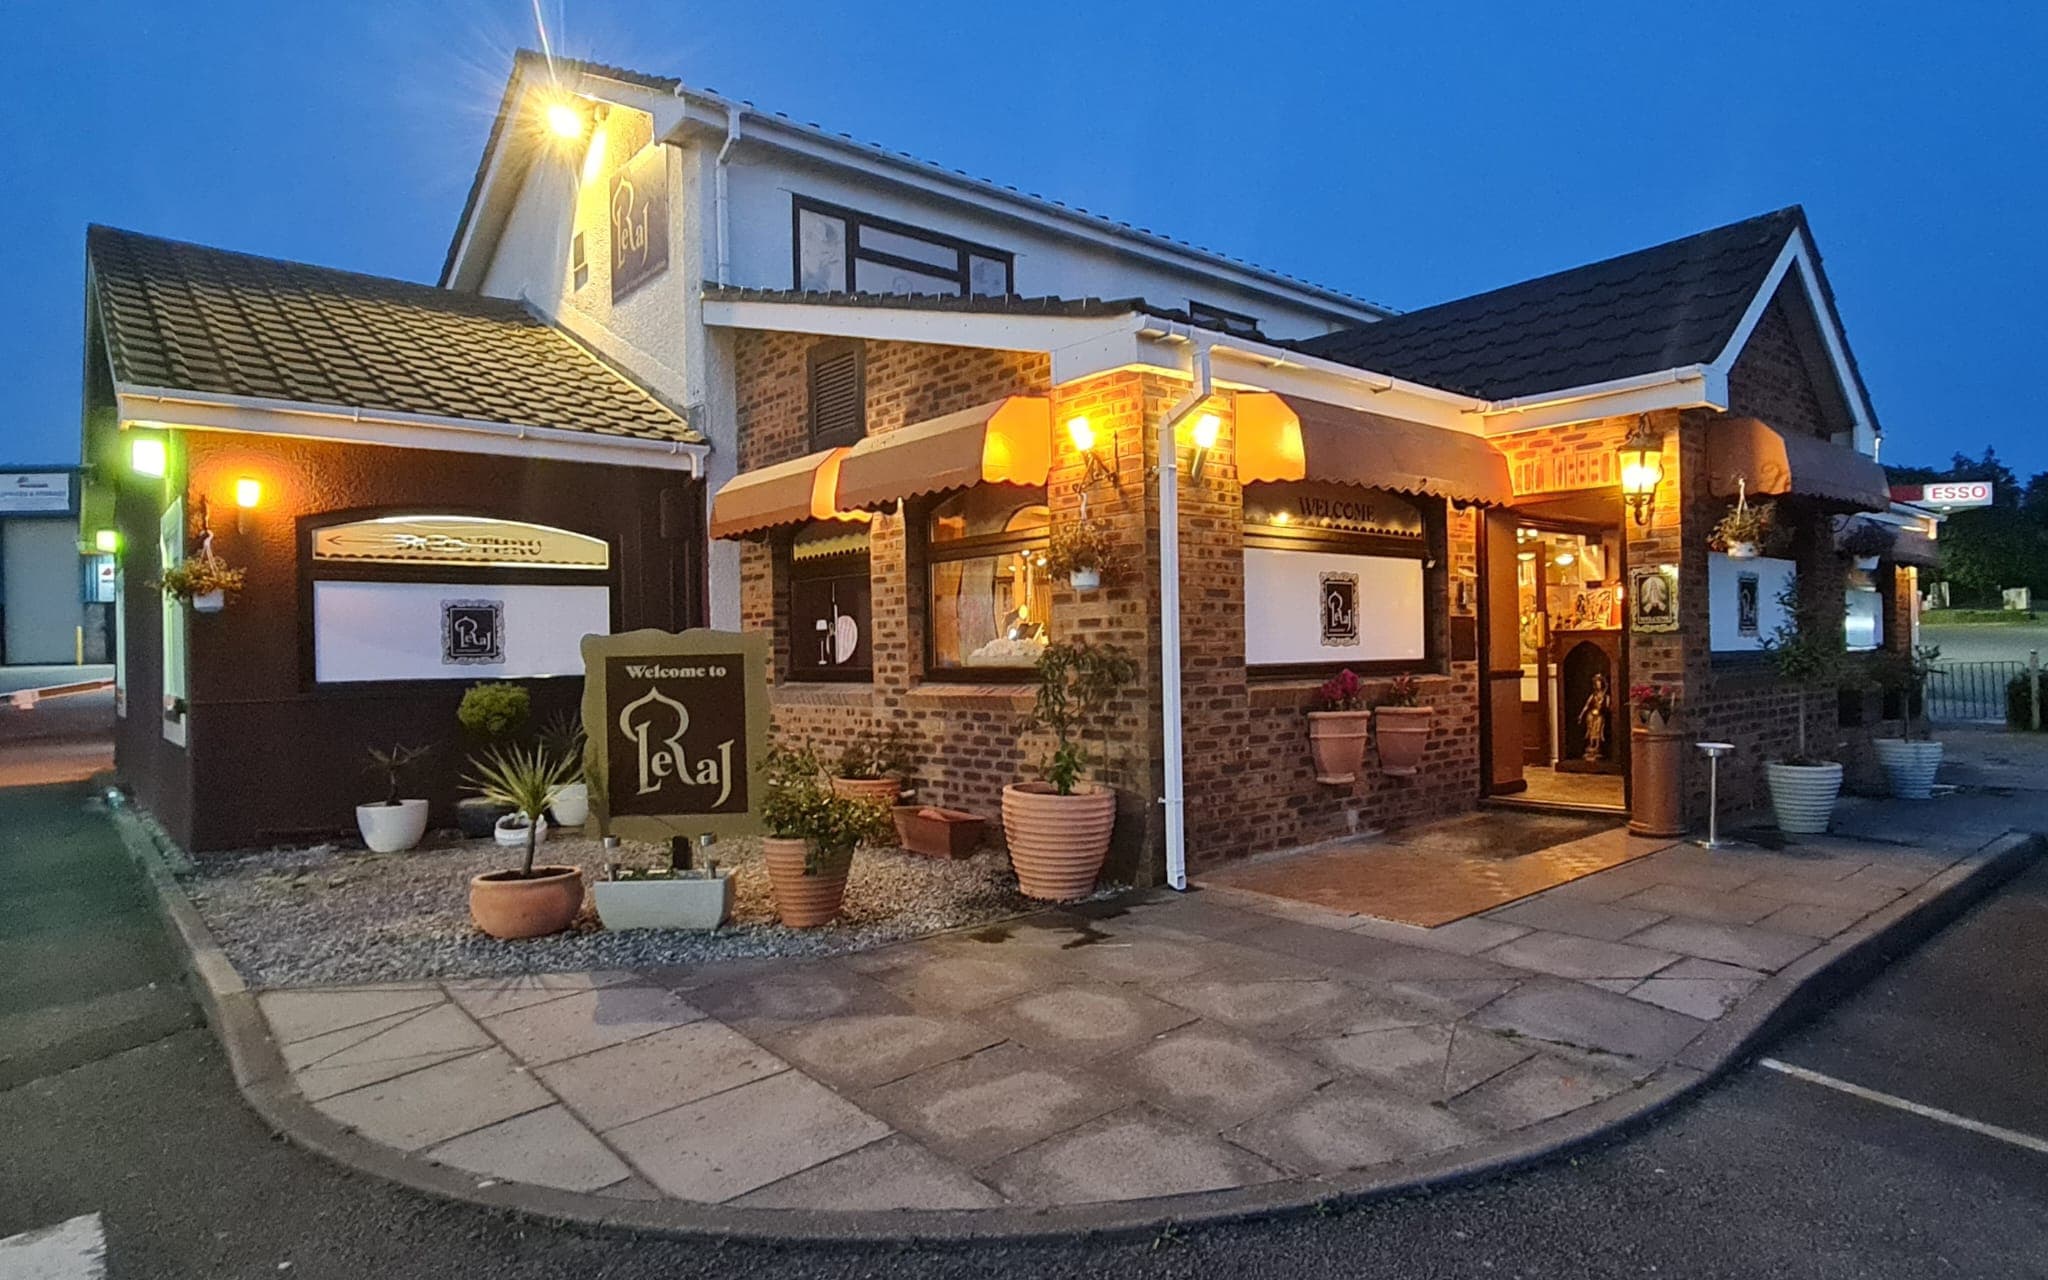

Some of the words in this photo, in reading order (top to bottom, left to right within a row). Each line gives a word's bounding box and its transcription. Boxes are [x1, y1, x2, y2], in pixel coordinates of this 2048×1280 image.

[1932, 485, 1987, 499] ESSO
[1298, 497, 1376, 522] WELCOME
[625, 664, 706, 679] Welcome
[709, 665, 727, 677] to
